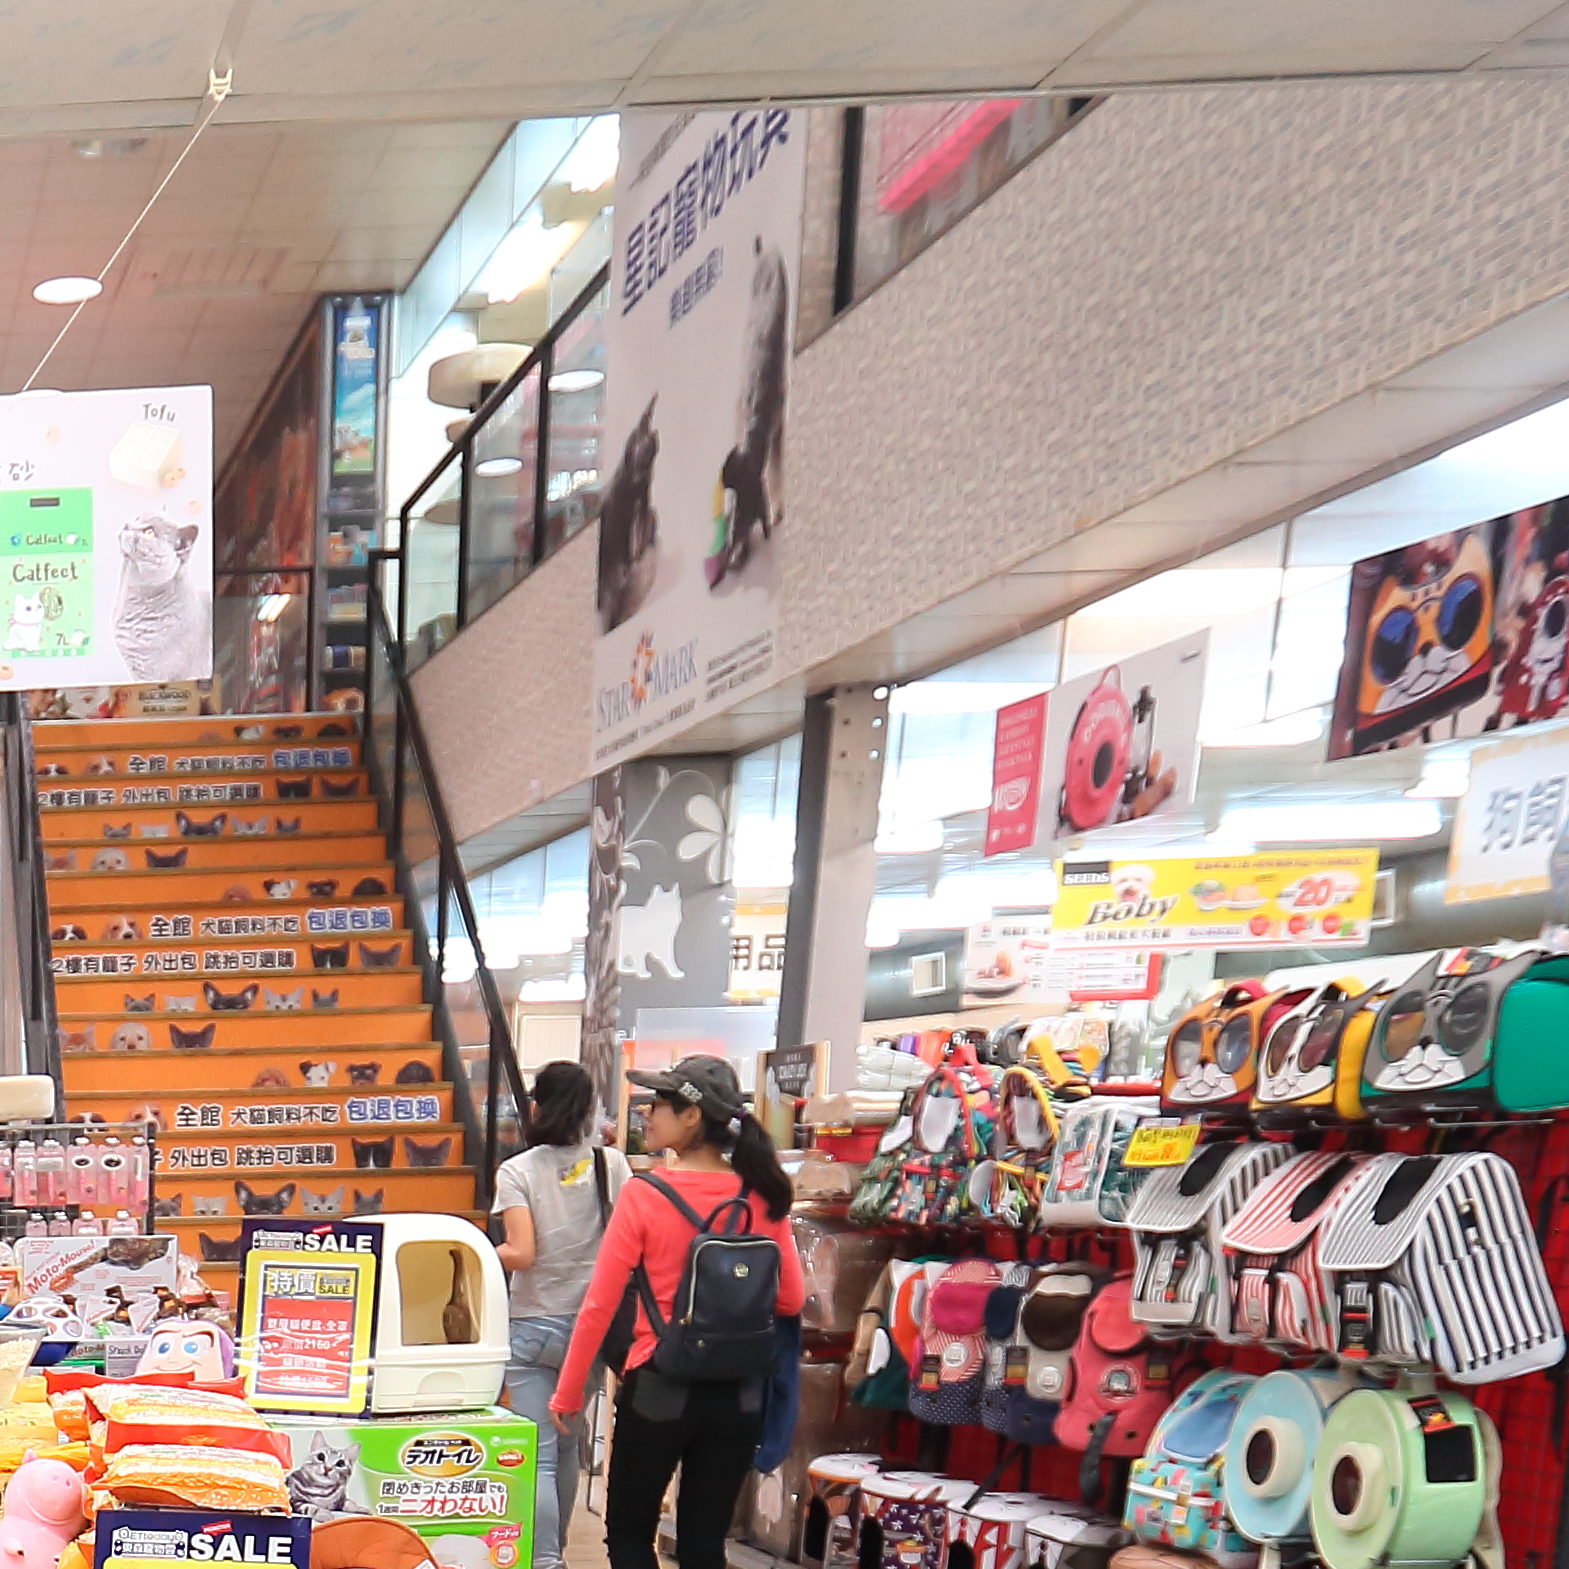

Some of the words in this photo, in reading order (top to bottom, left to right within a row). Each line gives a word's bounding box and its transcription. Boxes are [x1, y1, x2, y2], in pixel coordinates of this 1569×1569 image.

[141, 402, 178, 423] Tofu
[11, 557, 79, 584] Catfeet
[1064, 871, 1111, 886] SEEDS
[1293, 877, 1334, 908] 20
[1083, 893, 1180, 926] Boby
[149, 915, 193, 939] 全館
[305, 907, 393, 932] 包退包換
[142, 952, 198, 972] 外出包
[174, 1104, 222, 1129] 全館
[229, 1104, 340, 1126] 犬貓飼料不吃
[345, 1096, 440, 1123] 包退包換
[169, 1147, 229, 1170] 外出包
[304, 1233, 373, 1253] SALE
[26, 1238, 97, 1294] Moto-Mouse!
[318, 1284, 350, 1295] SALE
[404, 1448, 482, 1466] デオトイレ
[189, 1534, 293, 1564] SALE
